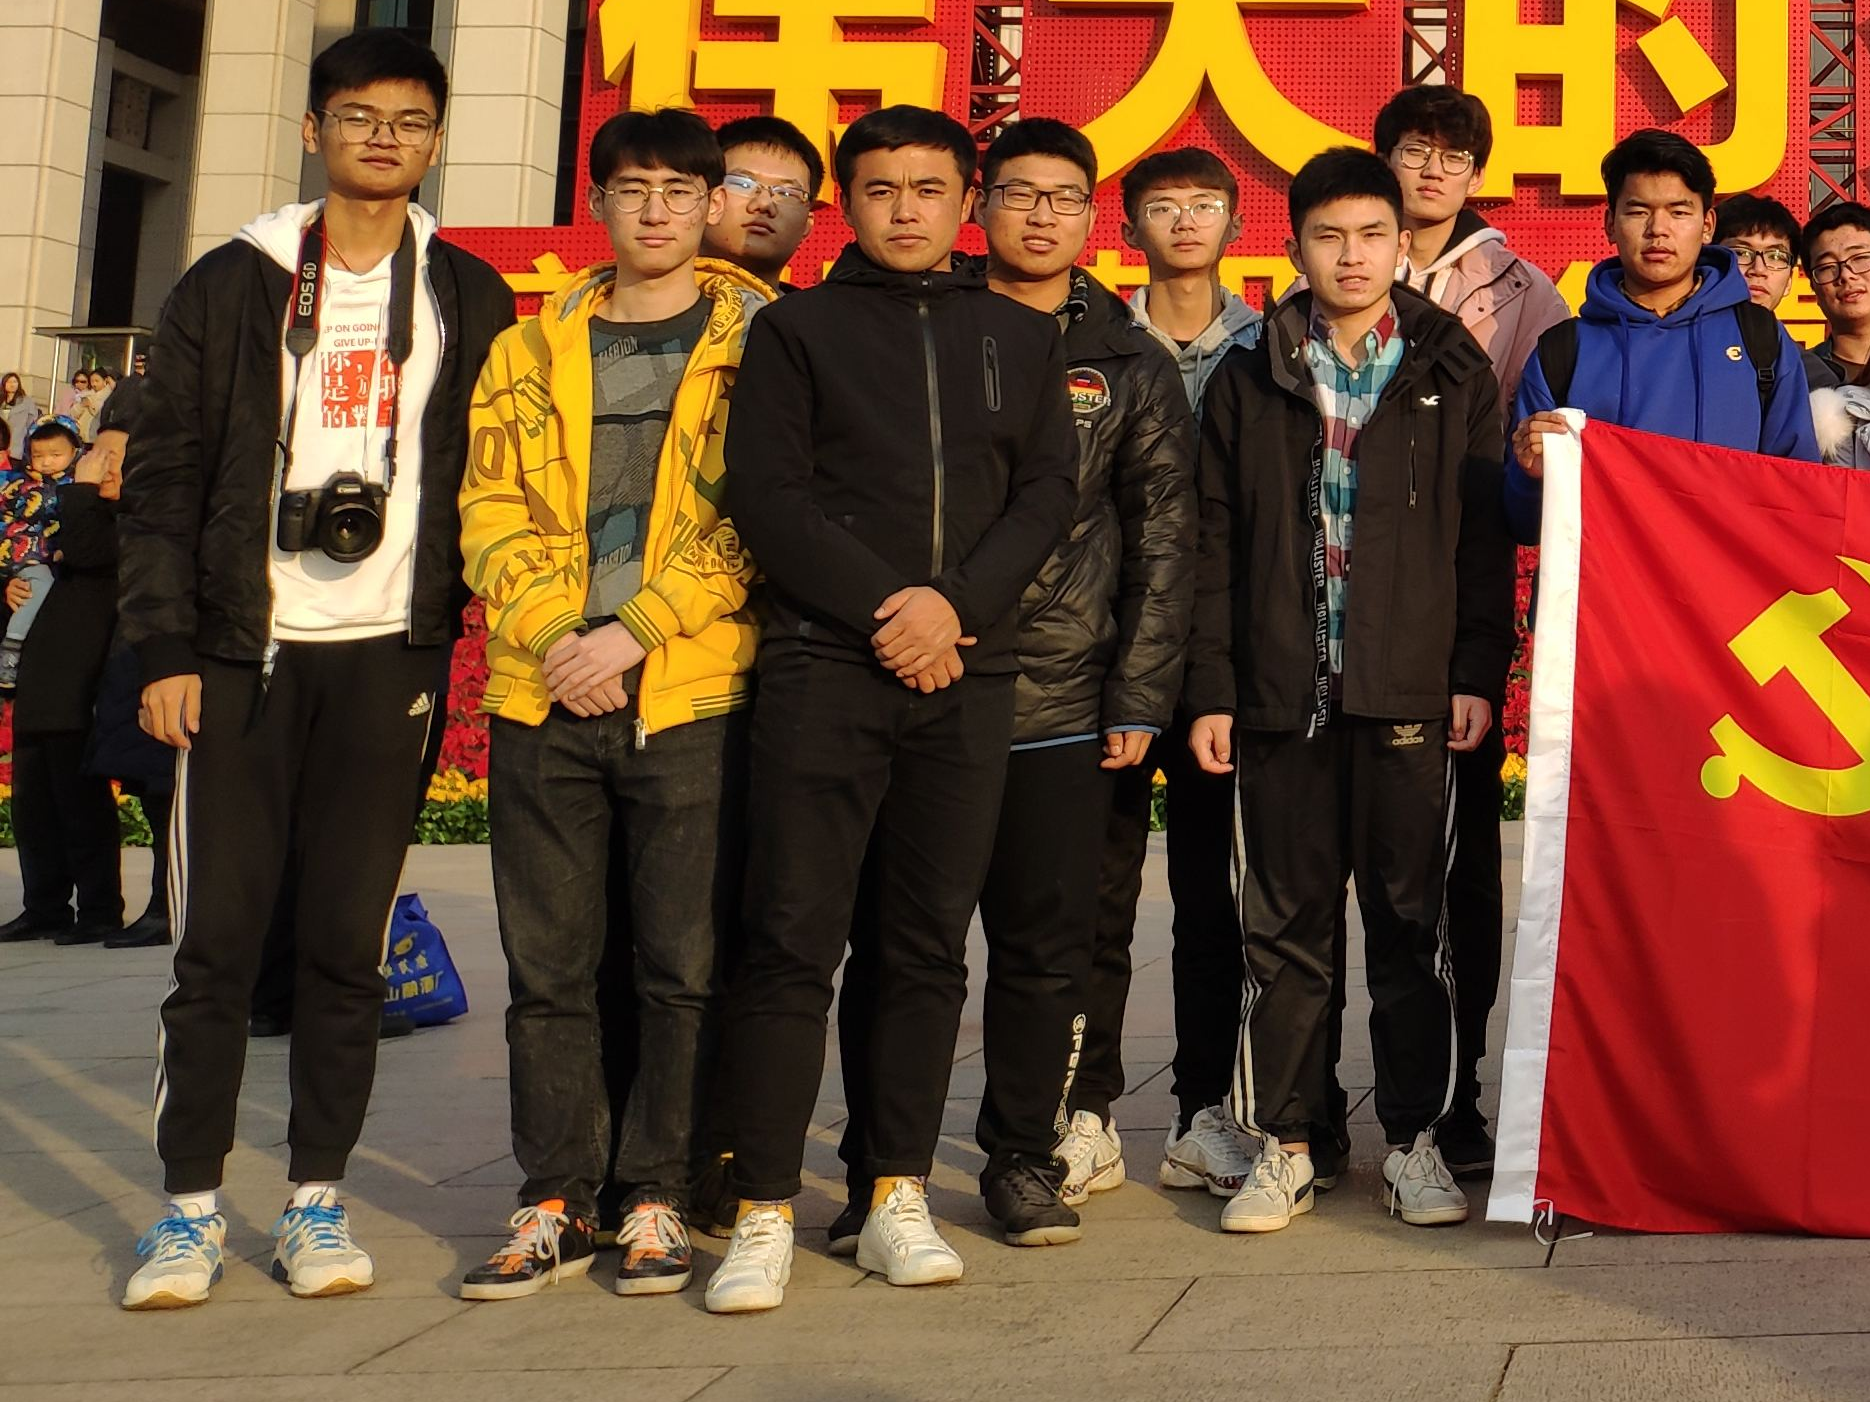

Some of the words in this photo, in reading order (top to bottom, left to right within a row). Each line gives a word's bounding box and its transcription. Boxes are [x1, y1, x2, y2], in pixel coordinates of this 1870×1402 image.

[303, 262, 317, 280] 6D
[299, 282, 315, 317] EOS
[353, 323, 380, 333] GOIN
[1313, 528, 1326, 588] HOLLISTER
